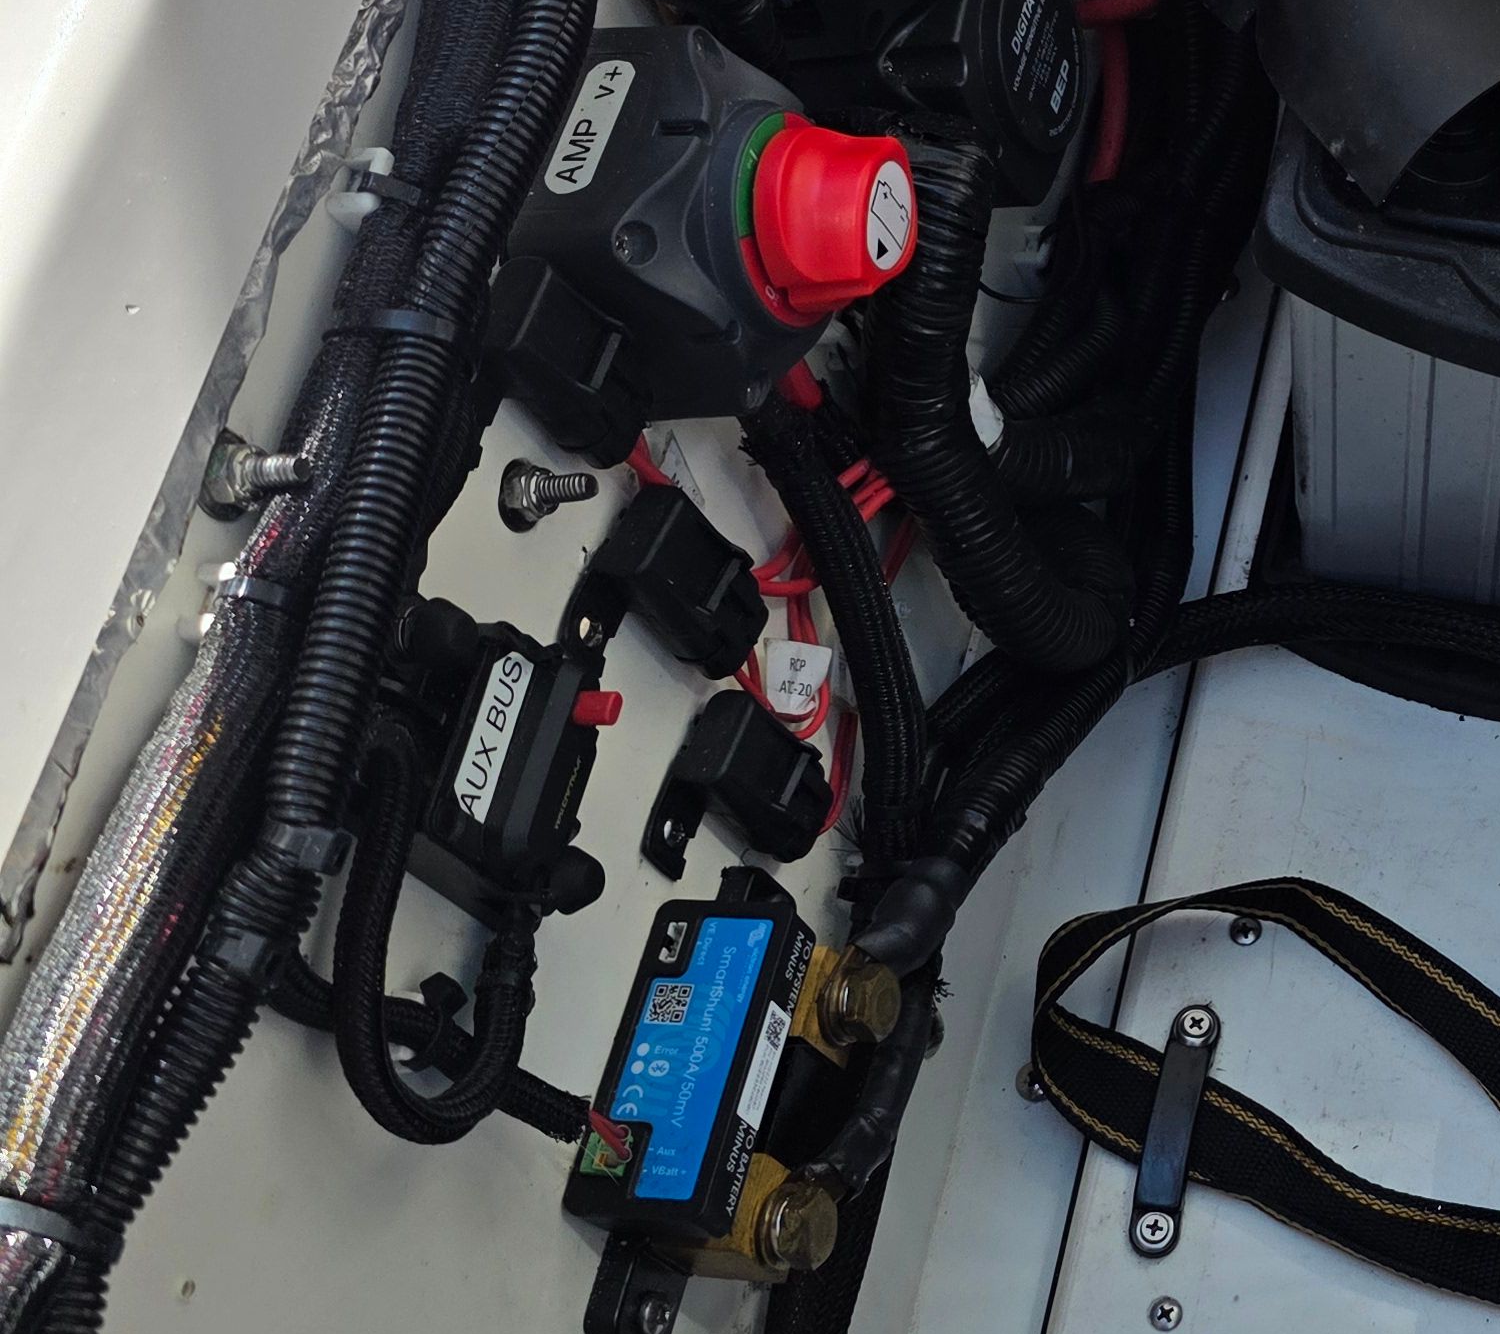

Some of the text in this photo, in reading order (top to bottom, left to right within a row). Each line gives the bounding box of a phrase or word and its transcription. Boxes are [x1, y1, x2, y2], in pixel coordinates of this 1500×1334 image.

[1043, 58, 1077, 114] BEP
[553, 115, 602, 185] AMP
[789, 657, 806, 671] RCP
[455, 655, 525, 818] AUX BUS
[745, 946, 760, 974] victron
[783, 930, 806, 980] MINUS
[783, 937, 814, 1016] TO SYSTEM
[734, 974, 750, 1003] energy
[652, 1043, 677, 1059] Error
[668, 943, 737, 1129] SmartShunt 500A/50mV
[656, 1145, 676, 1158] Aux
[724, 1119, 749, 1173] MINUS
[743, 1127, 757, 1150] TO
[722, 1150, 750, 1216] BATTERY
